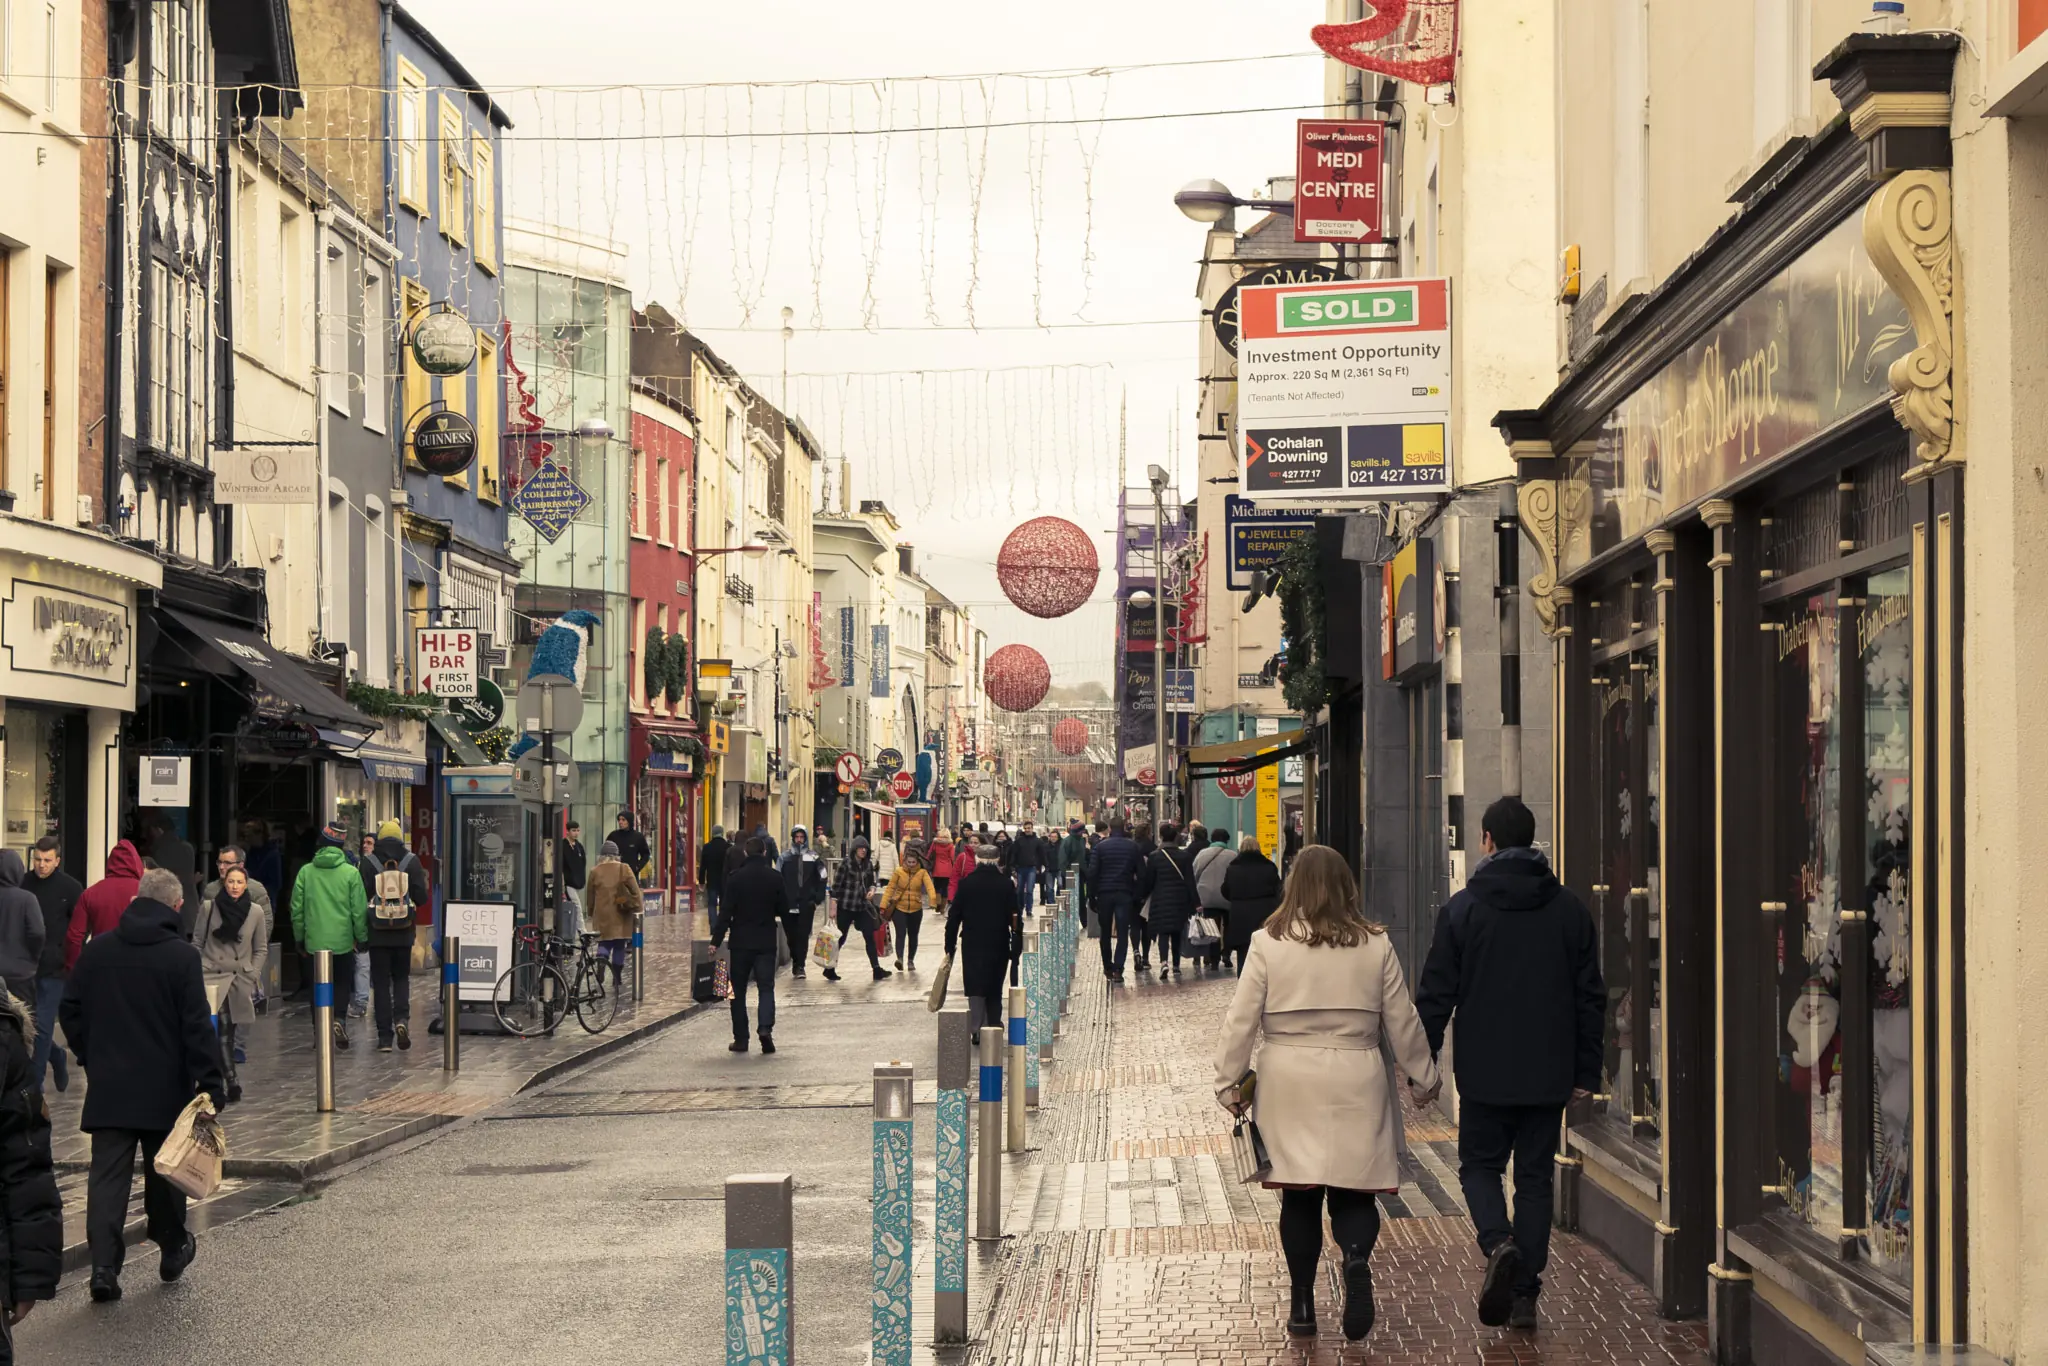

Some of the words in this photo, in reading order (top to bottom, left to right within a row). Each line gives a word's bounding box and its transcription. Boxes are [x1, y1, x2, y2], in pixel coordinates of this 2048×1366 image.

[1306, 132, 1330, 141] Oliver
[1332, 132, 1364, 142] Plunkett
[1366, 133, 1378, 142] St.
[1317, 152, 1363, 168] MEDI
[1301, 181, 1376, 198] CENTRE
[1300, 297, 1396, 322] SOLD
[1247, 347, 1337, 364] Investment
[1342, 343, 1441, 362] Opportunity
[1247, 369, 1290, 382] Approx.
[1292, 370, 1311, 380] 220
[1314, 369, 1328, 381] Sq
[1331, 369, 1341, 379] M
[1343, 367, 1374, 379] (2,361
[1377, 367, 1392, 379] Sq
[1395, 366, 1410, 377] Ft)
[1247, 393, 1285, 403] (Tenants
[1287, 392, 1304, 401] Not
[1304, 390, 1345, 401] Affected)
[1413, 388, 1428, 396] BER
[1703, 333, 1780, 465] Shoppe
[417, 431, 473, 448] GUINNESS
[1267, 436, 1324, 450] Cohalan
[1267, 450, 1328, 465] Downing
[1350, 457, 1390, 468] savills.ie
[1405, 449, 1442, 464] savills
[1350, 470, 1375, 483] 021
[1380, 469, 1406, 482] 427
[1411, 468, 1444, 481] 1371
[531, 481, 568, 489] ACADEMY
[523, 491, 562, 499] COLLEGE
[521, 500, 581, 509] HAIRDRESSING
[421, 633, 473, 653] HI-B
[429, 655, 465, 669] BAR
[438, 672, 469, 682] FIRST
[1127, 669, 1150, 687] Pop
[435, 684, 473, 693] FLOOR
[155, 765, 173, 775] rain
[894, 780, 912, 791] STOP
[461, 909, 498, 922] GIFT
[461, 923, 498, 936] SETS
[464, 955, 493, 969] rain
